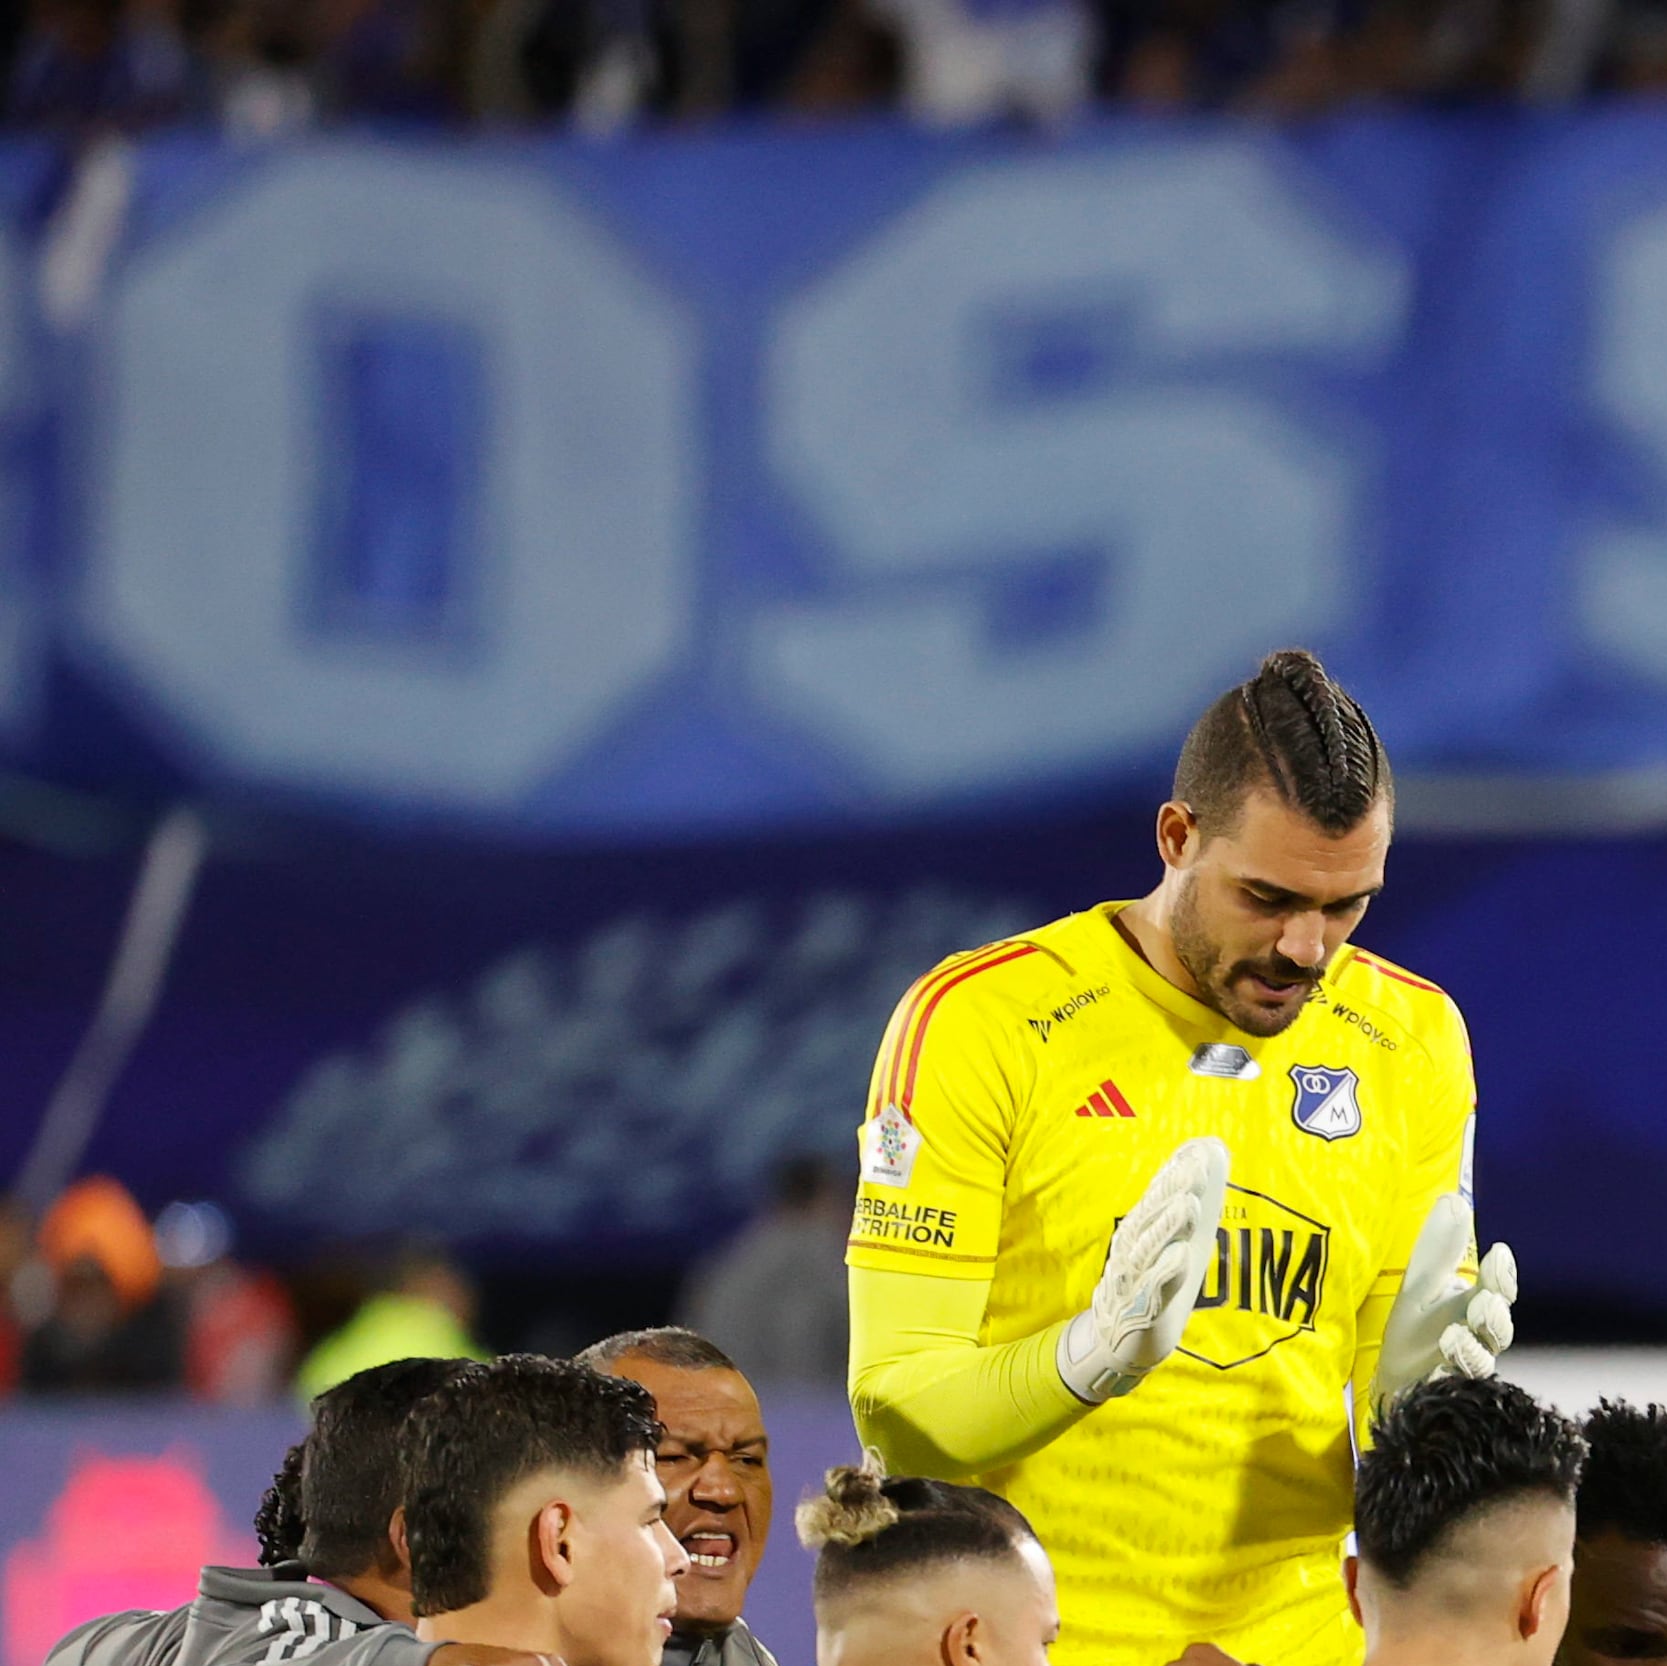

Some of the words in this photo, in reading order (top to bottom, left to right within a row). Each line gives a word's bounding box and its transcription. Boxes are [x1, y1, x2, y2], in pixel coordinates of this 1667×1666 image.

[40, 130, 1412, 815] OS
[856, 1197, 957, 1229] ERBALIFE
[1194, 1226, 1322, 1326] DINA
